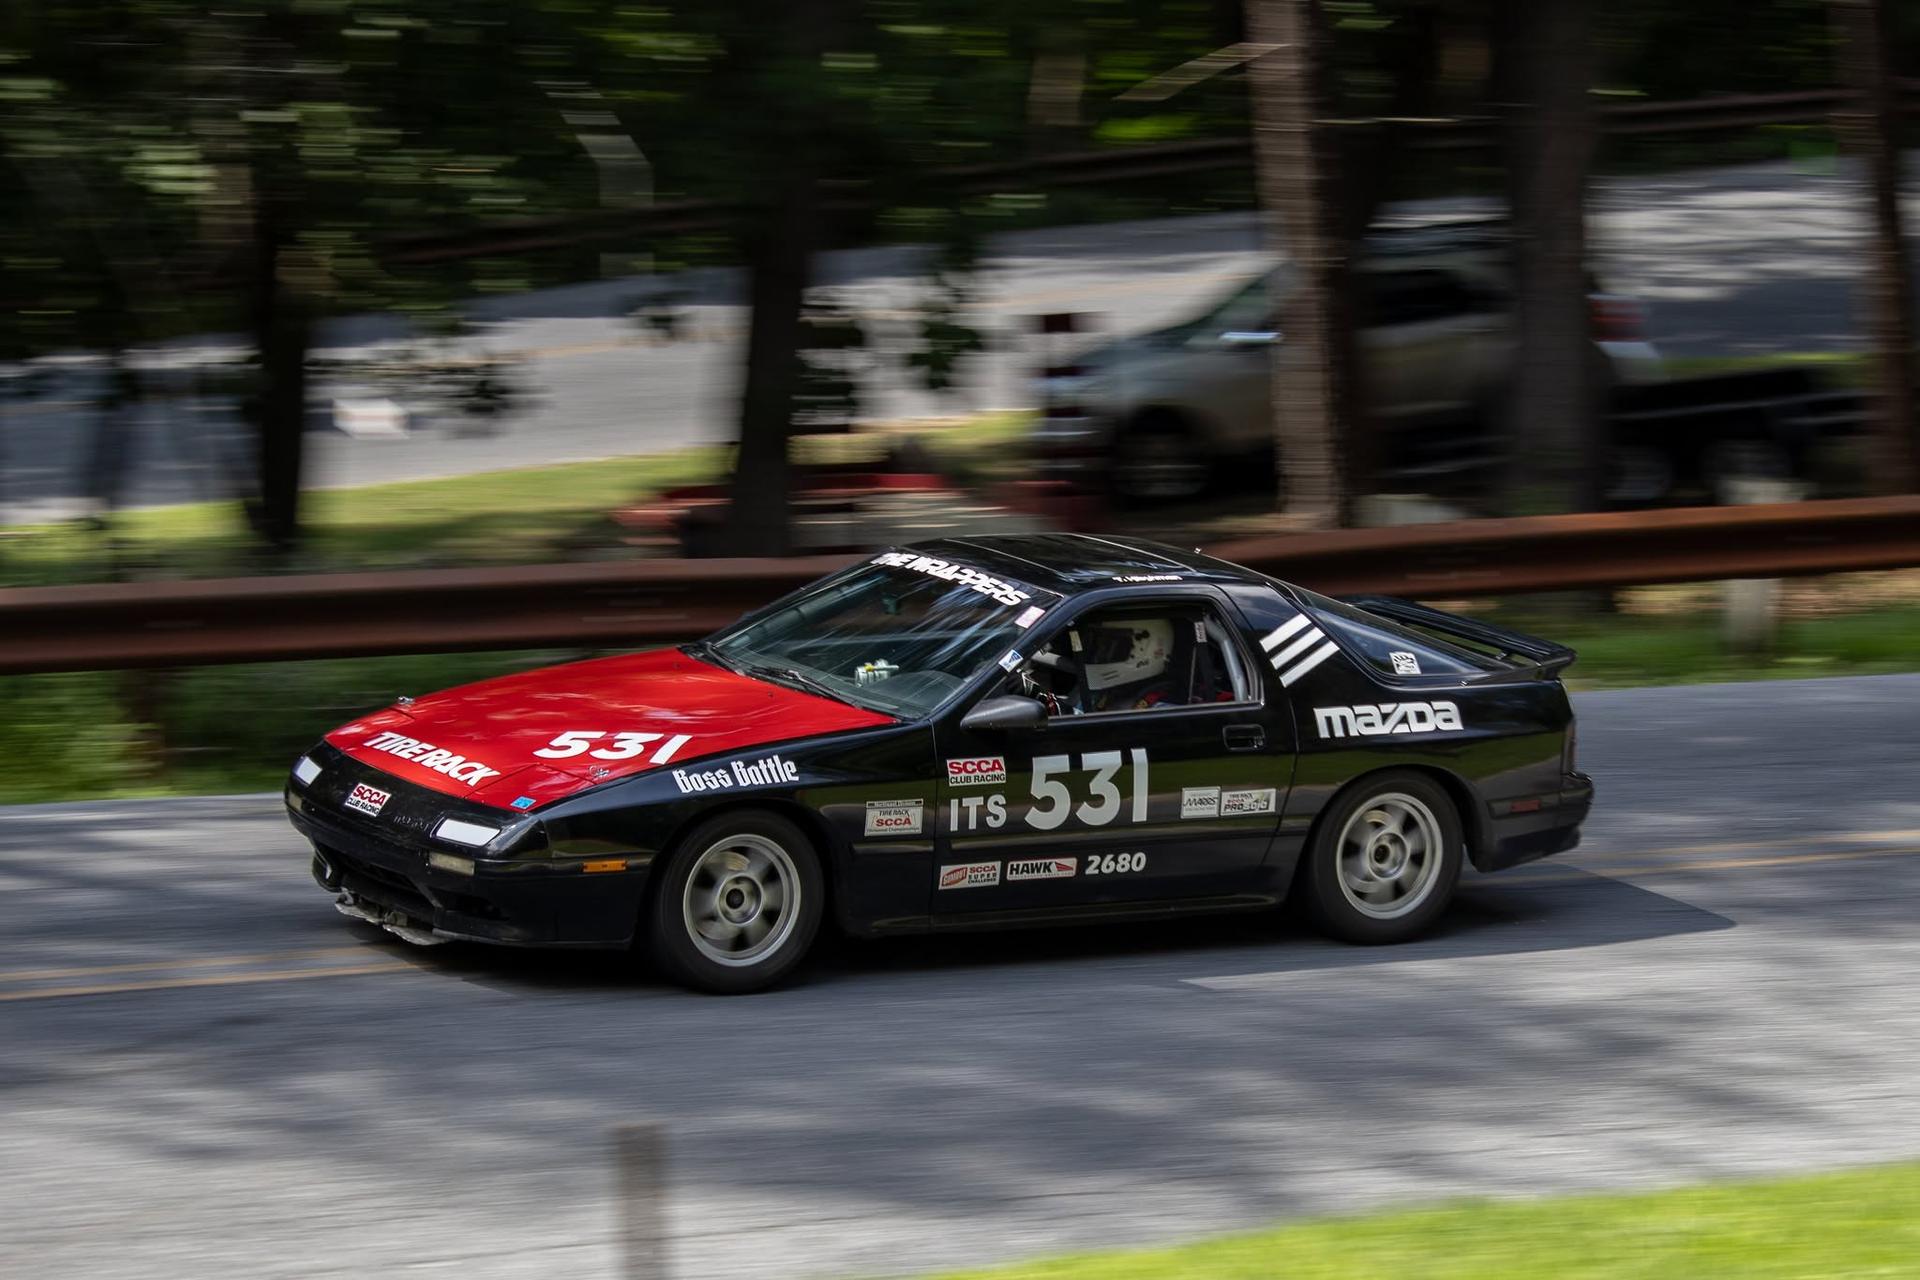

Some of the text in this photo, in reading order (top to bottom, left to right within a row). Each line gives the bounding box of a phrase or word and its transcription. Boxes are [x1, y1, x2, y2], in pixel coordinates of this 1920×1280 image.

[870, 553, 1031, 606] THE WRAPPERS
[1312, 701, 1464, 739] mazda
[533, 731, 693, 765] 531
[672, 755, 800, 793] Boss Battle
[948, 758, 1005, 774] SCCA
[949, 773, 1006, 784] CLUB RACING
[1024, 748, 1149, 830] 531
[352, 786, 388, 806] SCCA
[347, 798, 380, 816] CLUB RACING
[950, 794, 1007, 832] ITS
[876, 818, 911, 827] SCCA
[969, 865, 997, 873] SCCA
[1009, 861, 1054, 875] HAWK
[1085, 852, 1147, 875] 2680
